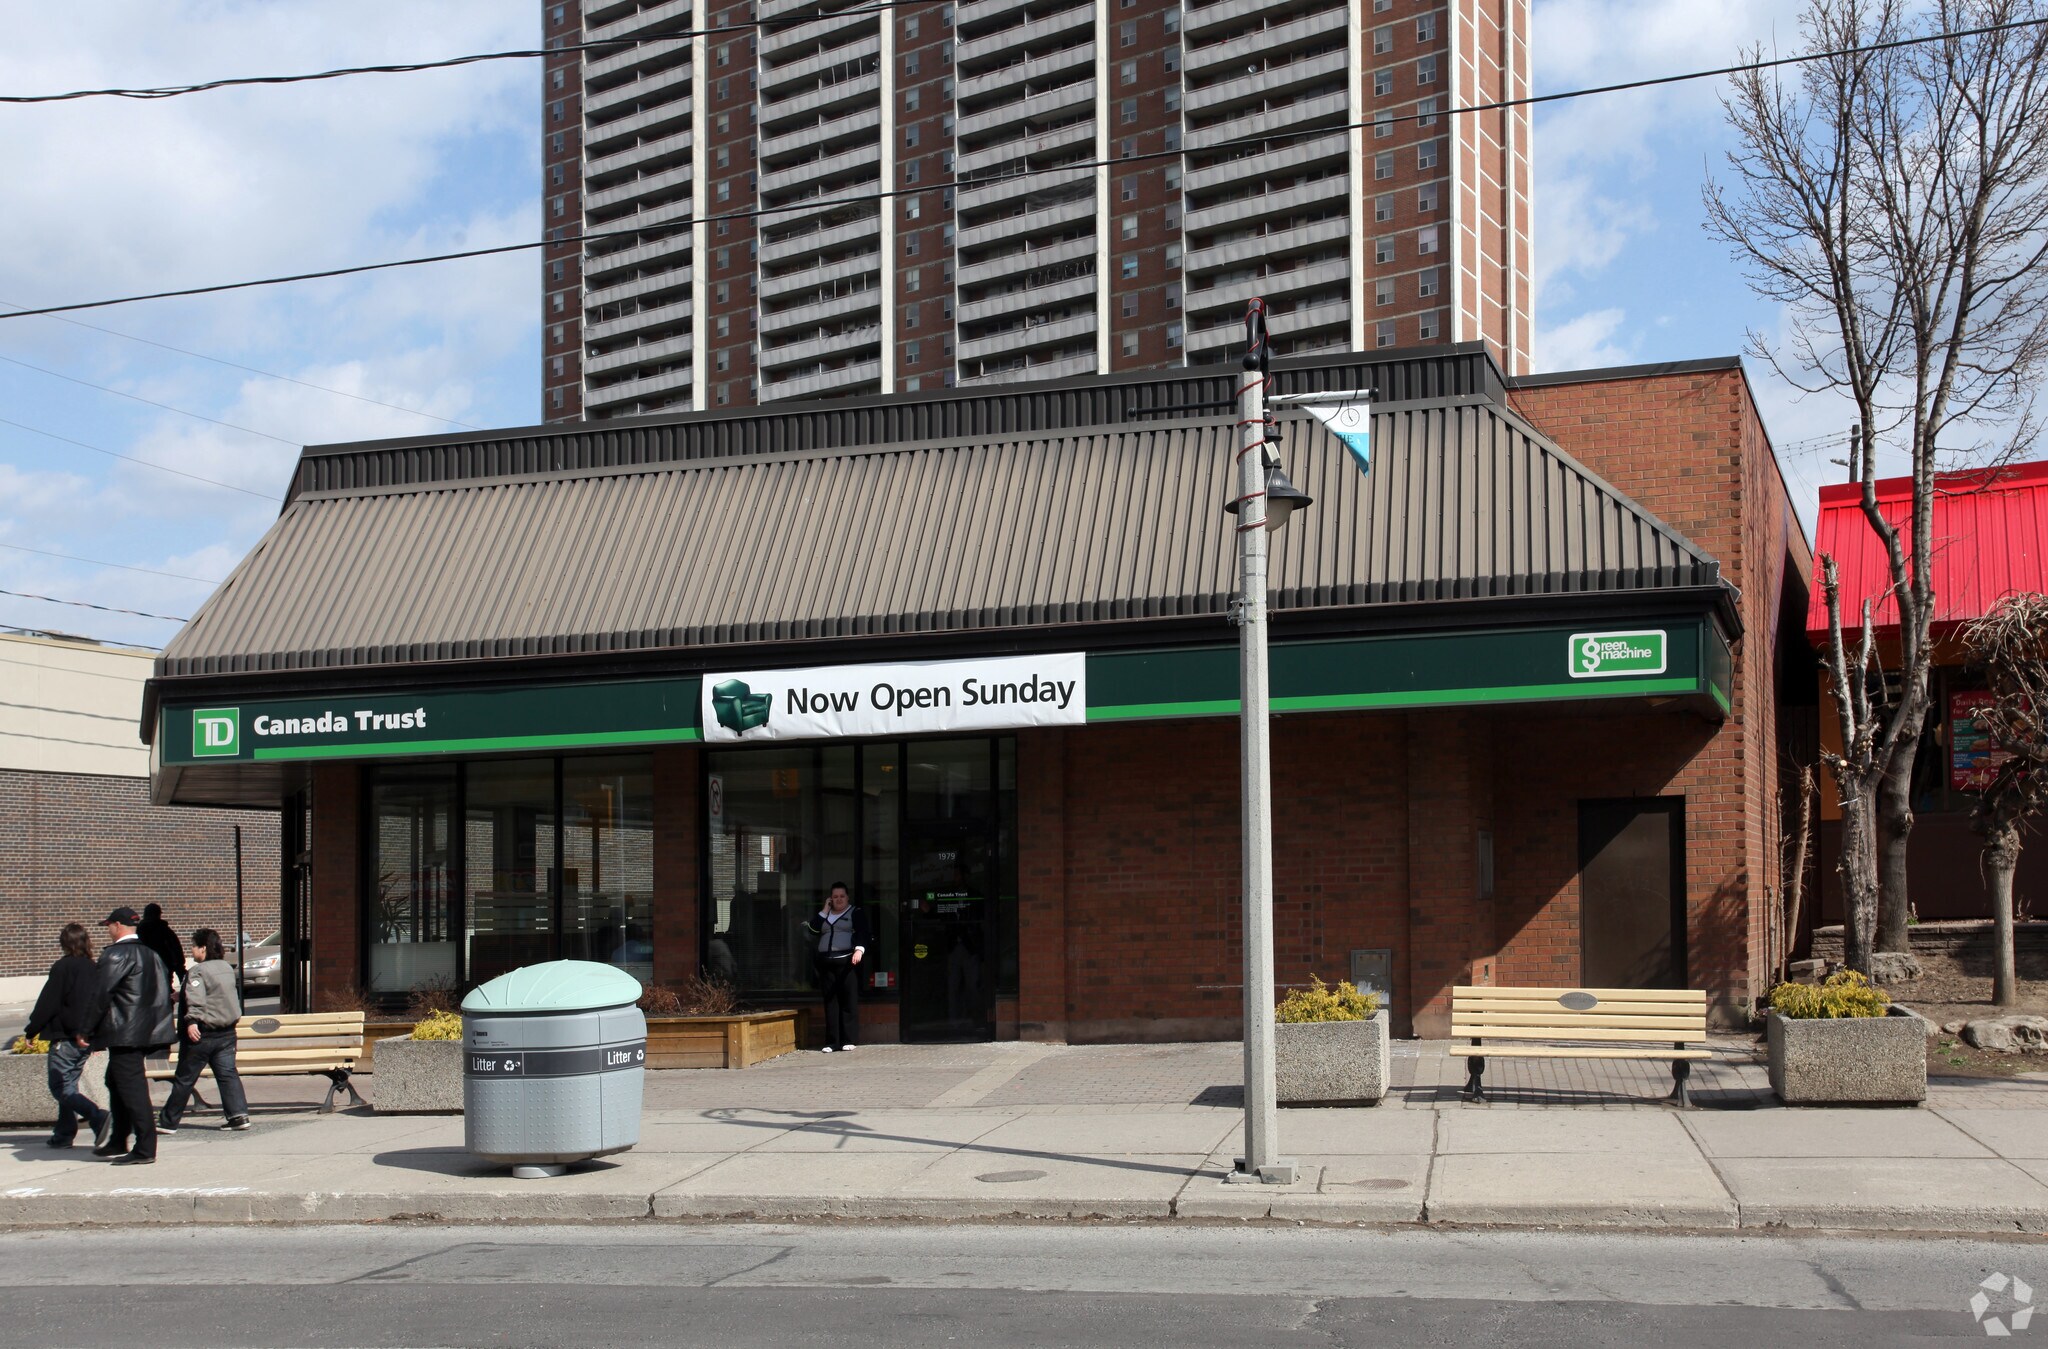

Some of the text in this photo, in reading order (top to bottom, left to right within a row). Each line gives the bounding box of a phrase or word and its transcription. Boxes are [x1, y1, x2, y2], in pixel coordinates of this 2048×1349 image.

[1601, 646, 1652, 660] machine
[787, 673, 1076, 717] Now Open Sunday
[1955, 699, 1976, 707] Daily
[197, 707, 426, 747] TD Canada Trust
[472, 1056, 496, 1072] Litter
[607, 1050, 632, 1066] Litter
